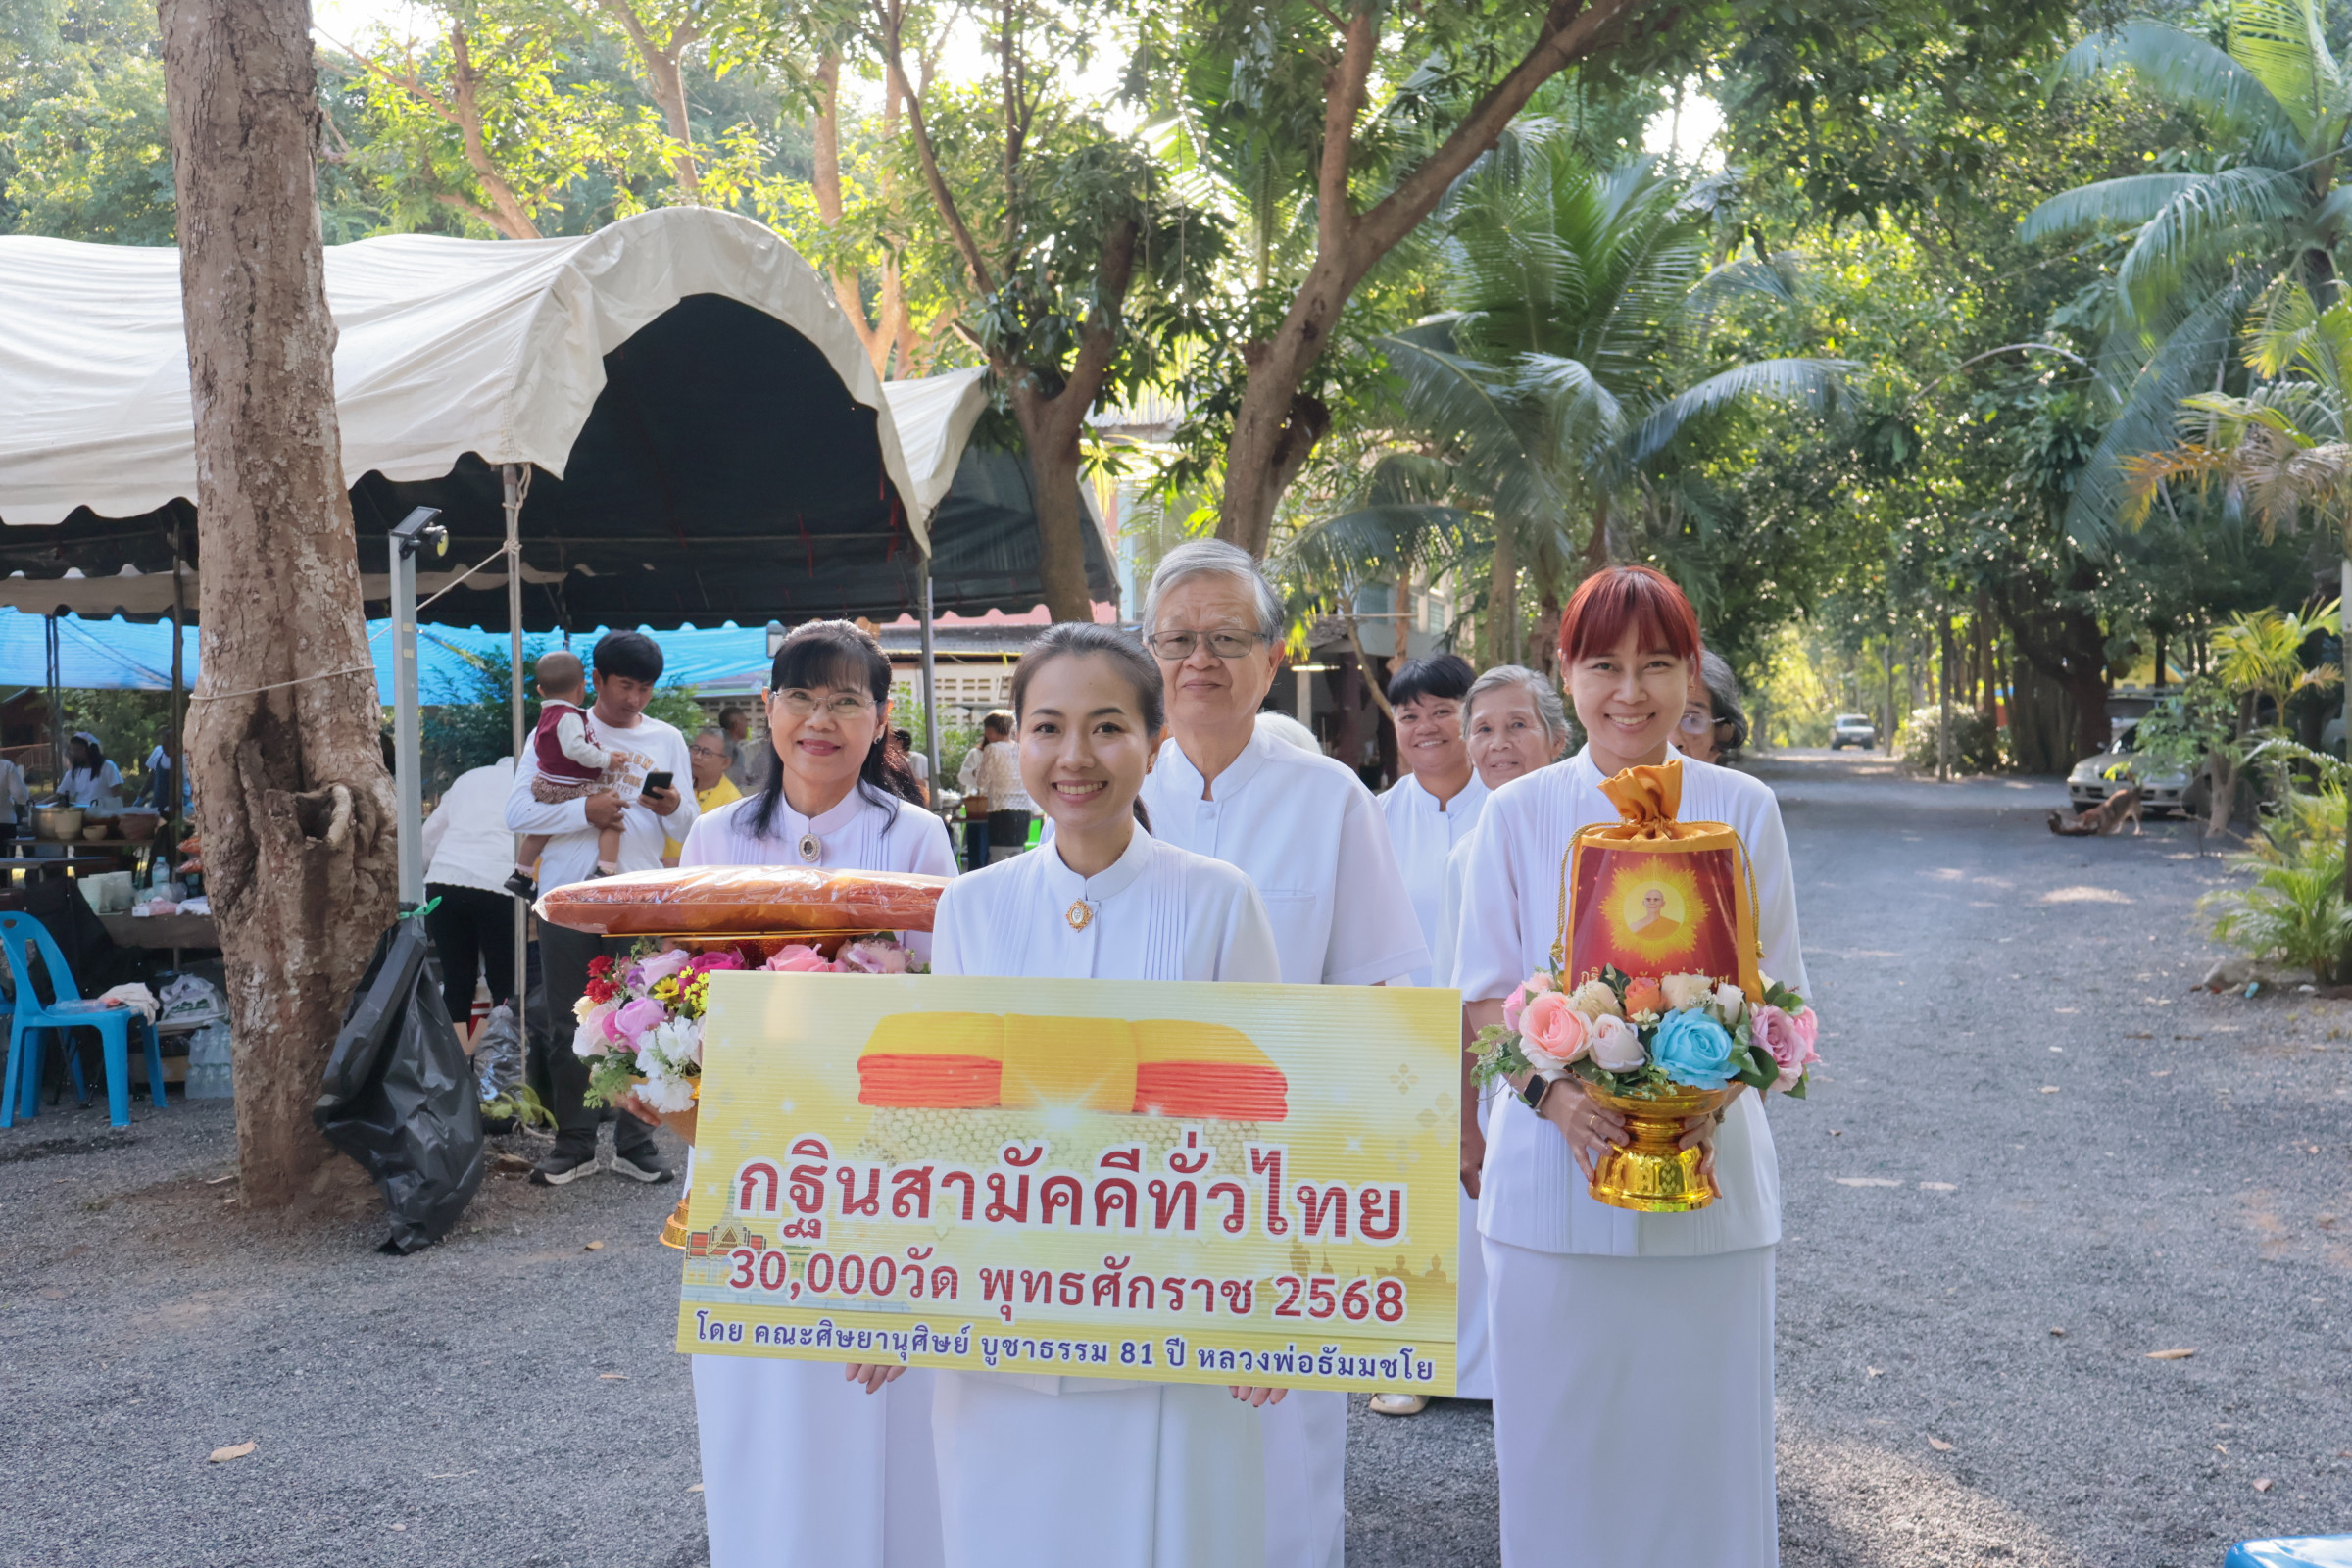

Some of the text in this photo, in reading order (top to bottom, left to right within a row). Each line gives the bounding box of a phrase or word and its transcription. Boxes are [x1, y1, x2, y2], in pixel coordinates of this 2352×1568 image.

[739, 1130, 1401, 1240] กฐินสามัคคีทั่วไทย
[729, 1246, 1404, 1322] 30,000วัด พุทธศักราช 2568
[696, 1310, 1434, 1381] โดย คณะศิษยานุศิษย์ บูชาธรรม 81 ปี หลวงพ่อธัมมชโย
